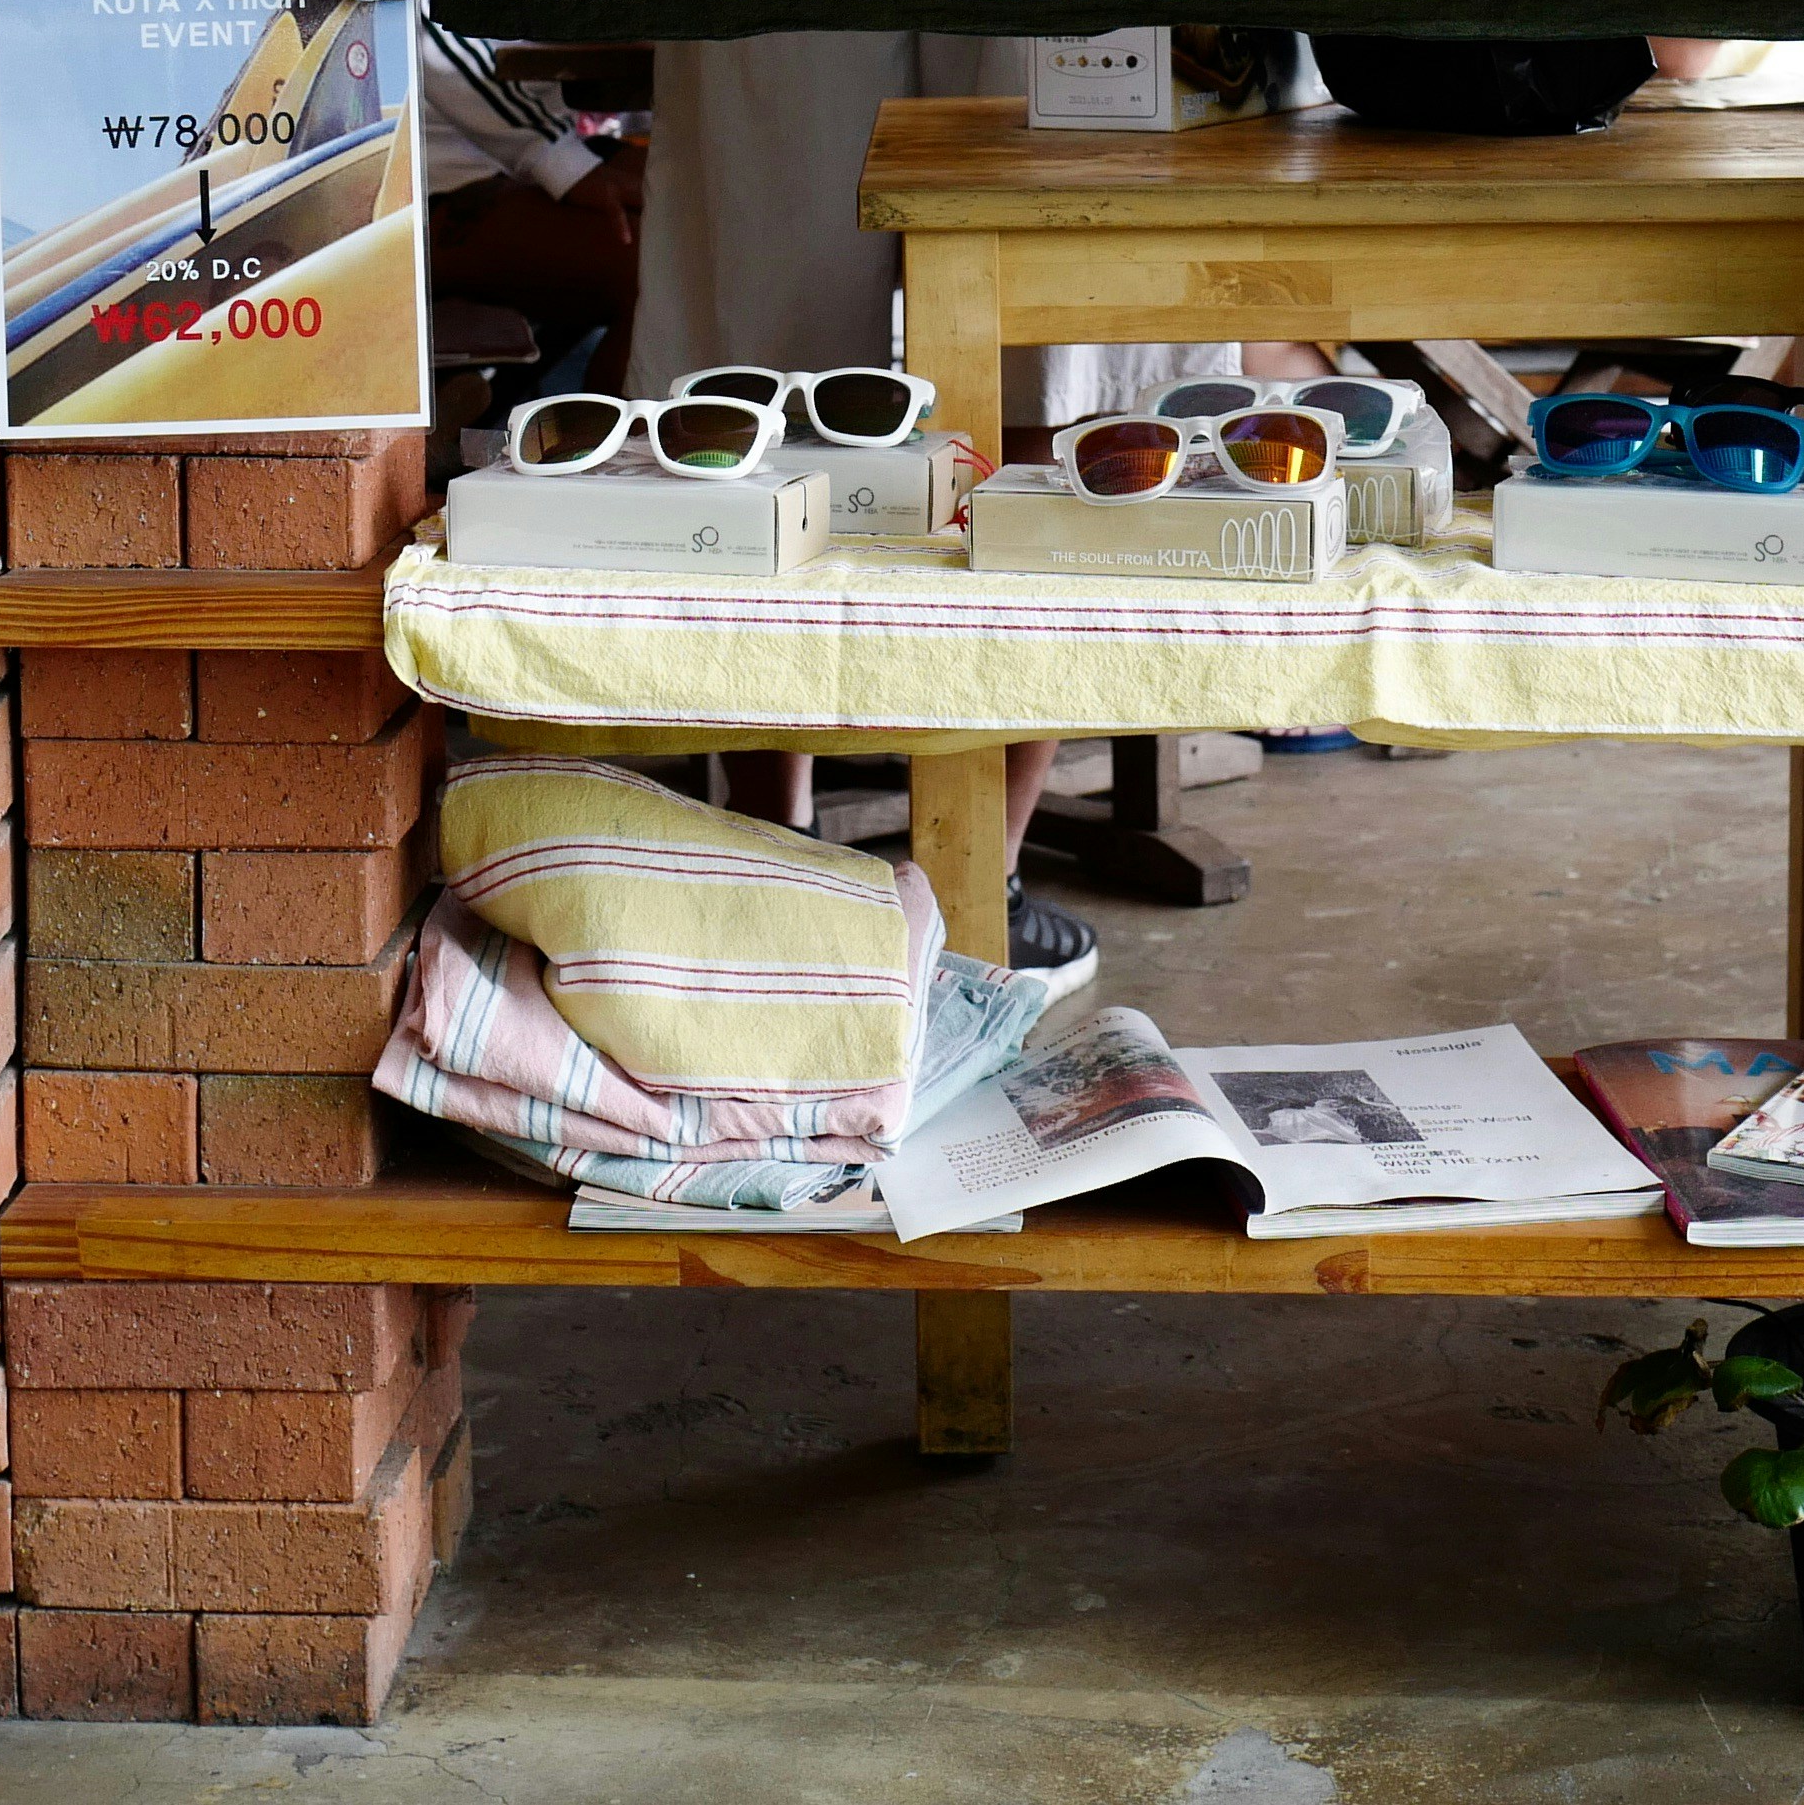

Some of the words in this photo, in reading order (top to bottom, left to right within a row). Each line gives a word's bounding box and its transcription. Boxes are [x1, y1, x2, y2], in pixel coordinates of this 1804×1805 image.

[141, 21, 256, 48] EVENT
[102, 111, 294, 155] ₩78,000
[146, 259, 199, 281] 20%
[212, 258, 261, 280] D.C
[91, 297, 322, 345] ₩62,000
[1050, 551, 1075, 563] THE
[1079, 552, 1114, 565] SOUL
[1117, 553, 1152, 566] FROM
[1158, 550, 1211, 568] KUTA
[1094, 1015, 1125, 1026] 123
[1104, 1114, 1171, 1136] foreign
[1377, 1158, 1432, 1167] WHAT
[1437, 1157, 1475, 1165] THE
